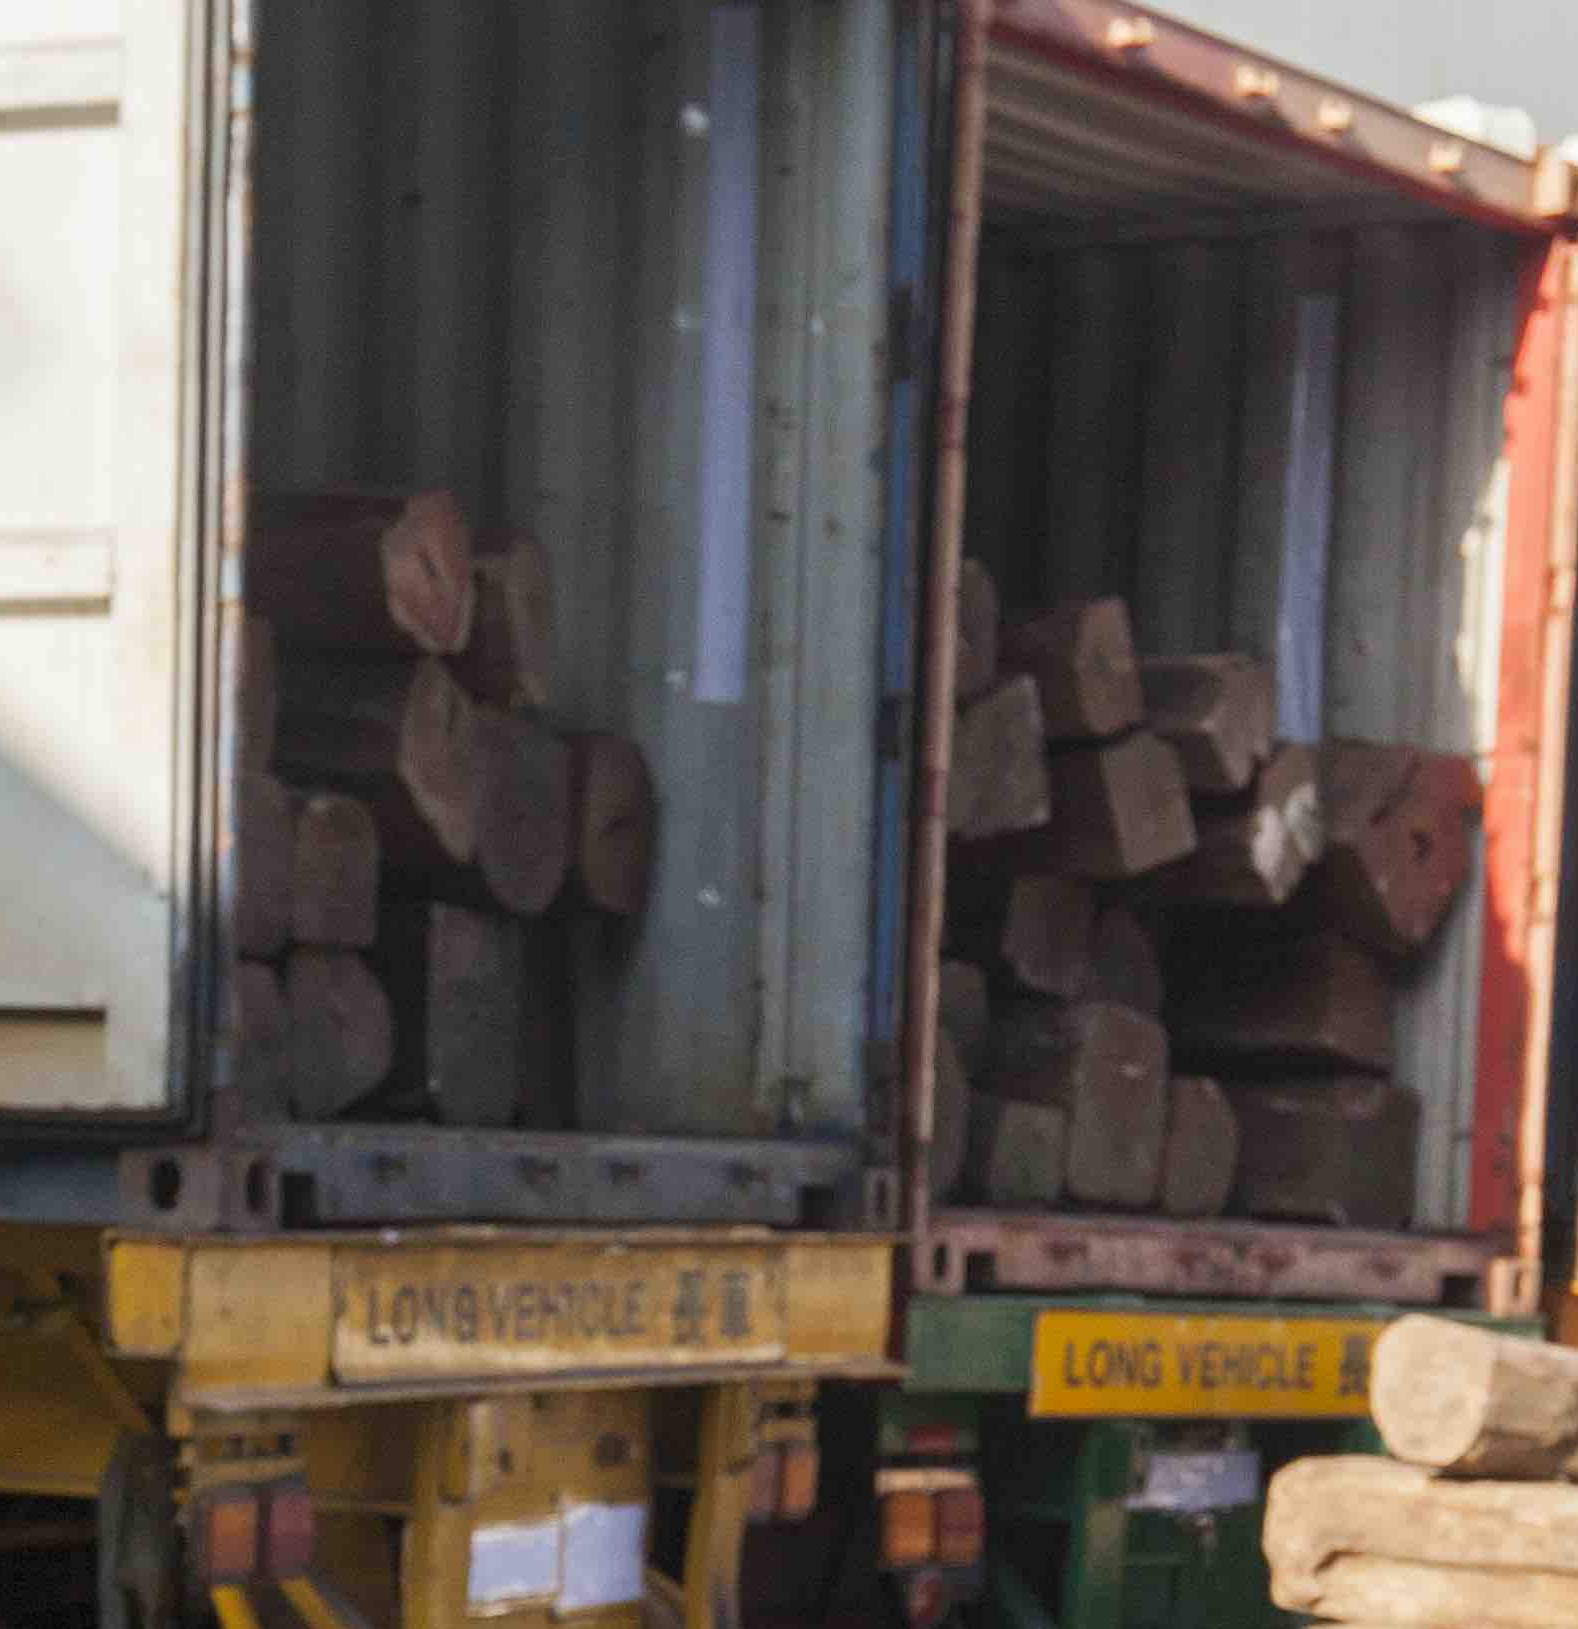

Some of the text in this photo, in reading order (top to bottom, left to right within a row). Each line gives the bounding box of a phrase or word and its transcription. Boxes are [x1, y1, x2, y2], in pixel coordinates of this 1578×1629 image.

[366, 1283, 479, 1346] LONG
[485, 1280, 648, 1342] VEHICLE
[1062, 1338, 1164, 1389] LONG
[1175, 1341, 1319, 1392] VEHICLE
